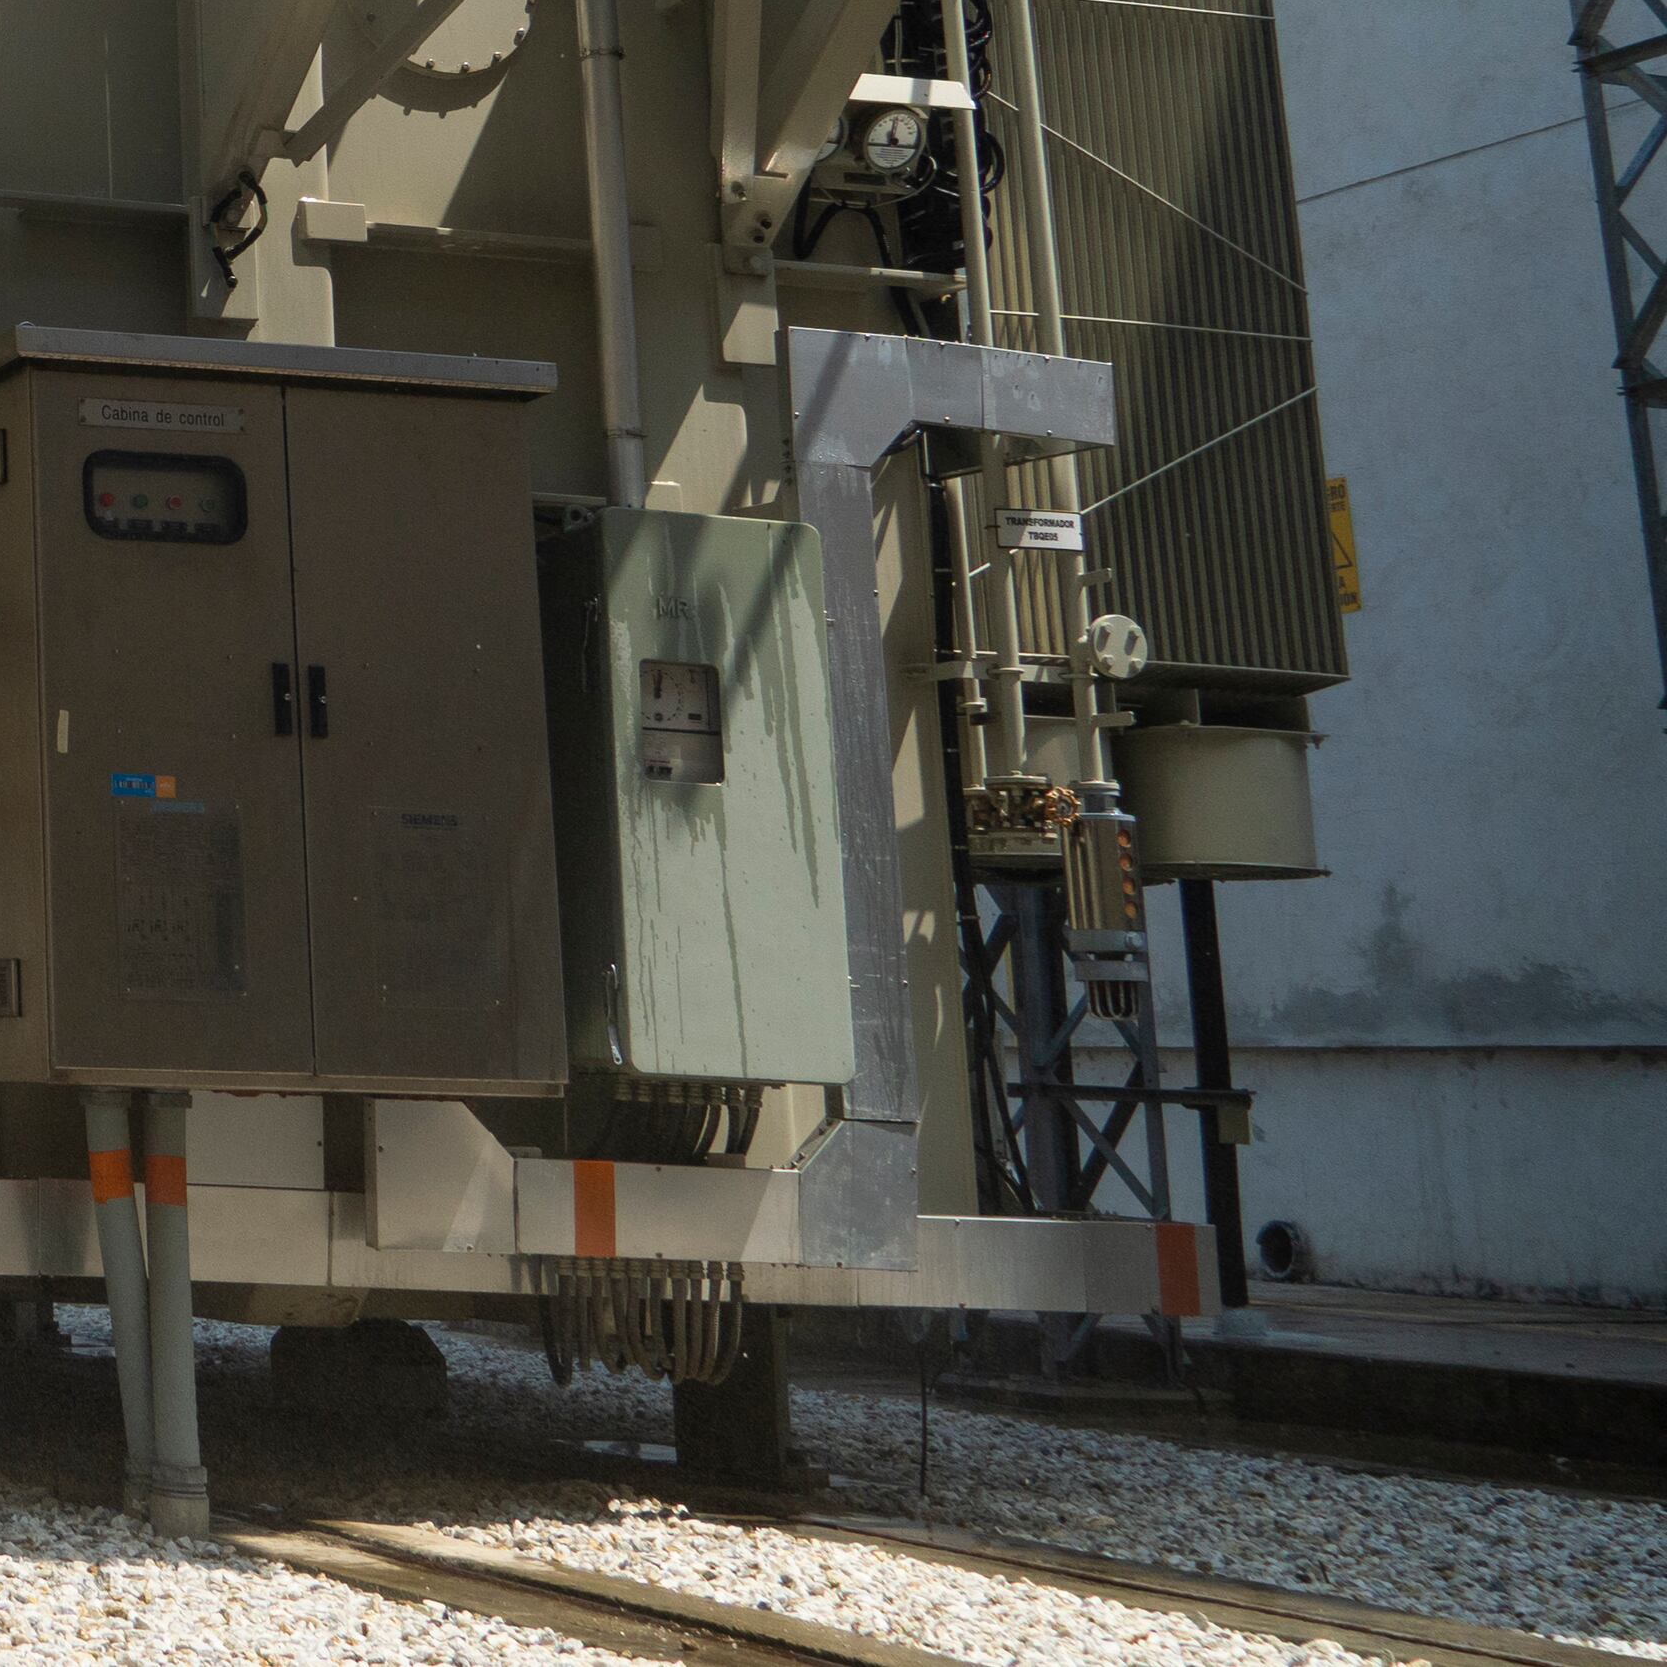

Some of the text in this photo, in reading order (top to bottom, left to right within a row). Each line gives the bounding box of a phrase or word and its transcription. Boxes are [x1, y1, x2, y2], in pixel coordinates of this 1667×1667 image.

[101, 405, 225, 427] Cabina de control
[1005, 517, 1074, 528] TRANSFORMADOR
[657, 597, 688, 620] MR
